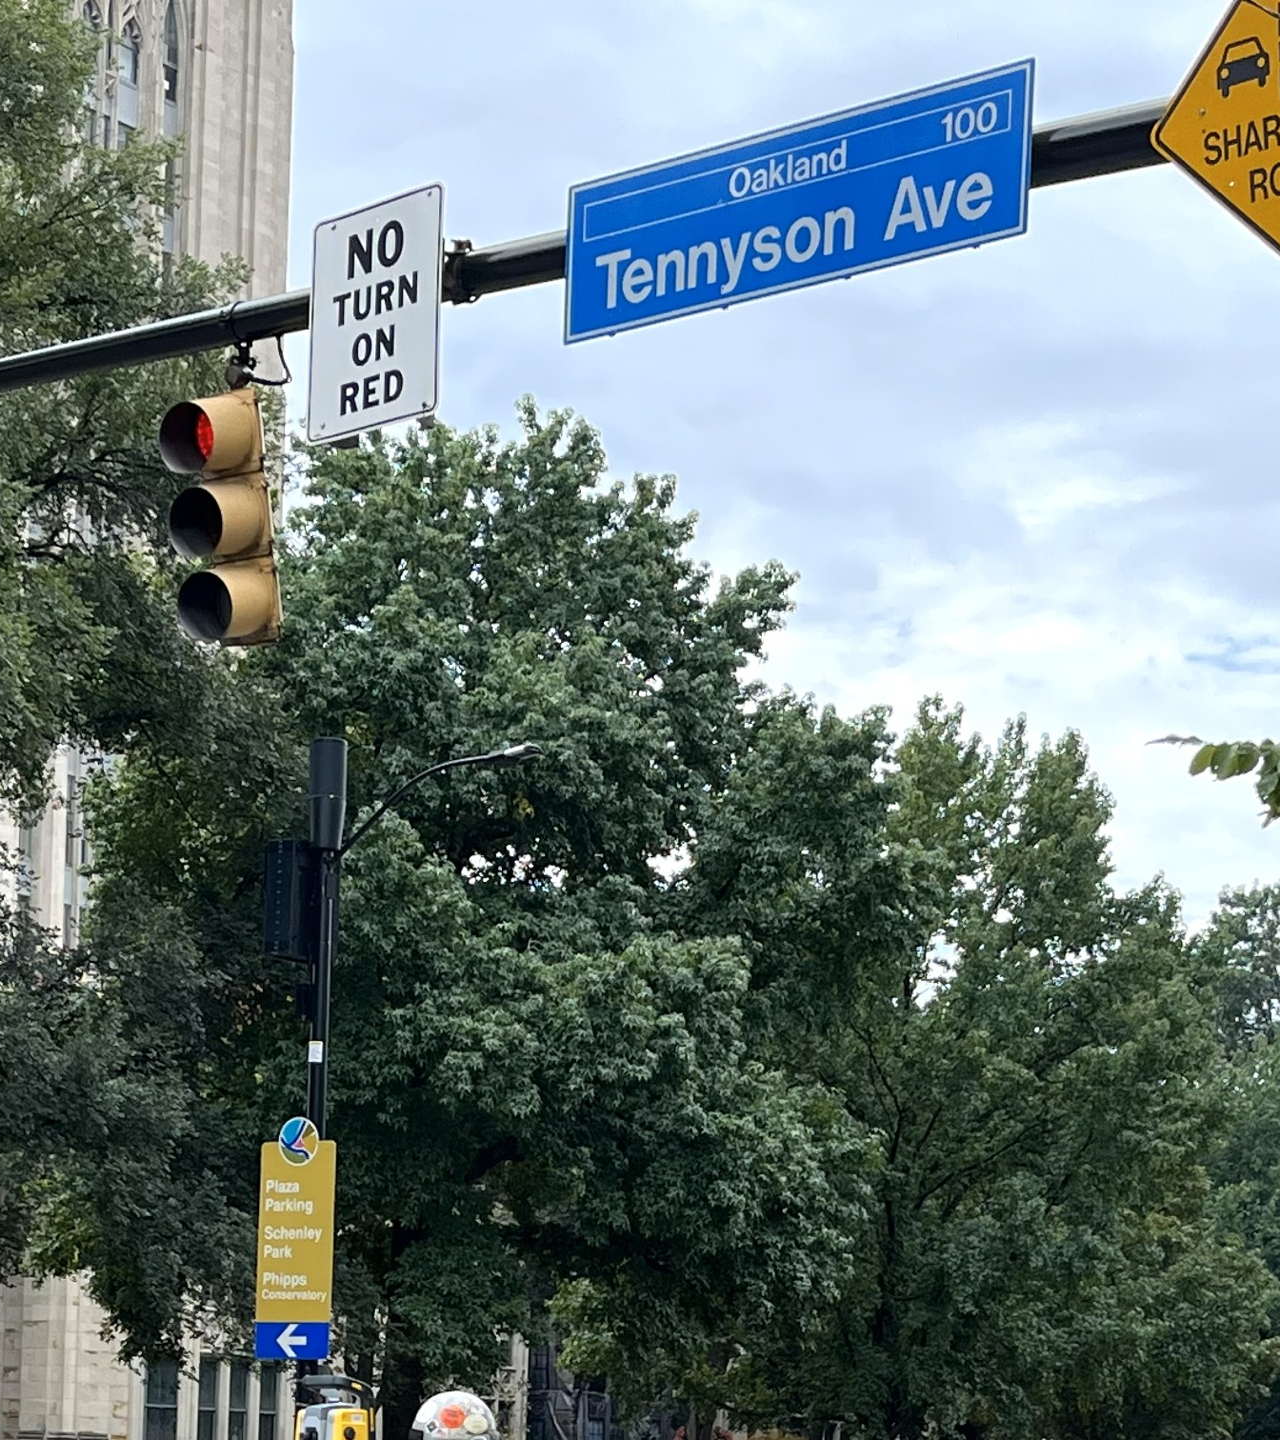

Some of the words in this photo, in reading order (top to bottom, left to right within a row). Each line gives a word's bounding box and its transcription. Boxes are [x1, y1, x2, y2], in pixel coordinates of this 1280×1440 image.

[939, 101, 999, 143] 100
[728, 138, 848, 200] Oakland
[348, 220, 403, 272] NO
[594, 206, 856, 310] Tennyson
[884, 165, 995, 237] Ave
[332, 271, 419, 321] TURN
[351, 325, 396, 368] ON
[340, 369, 404, 417] RED
[265, 1199, 314, 1214] Parking
[266, 1180, 300, 1193] Plaza
[263, 1246, 293, 1258] Park
[264, 1226, 322, 1242] Schenley
[262, 1272, 308, 1288] Phipps
